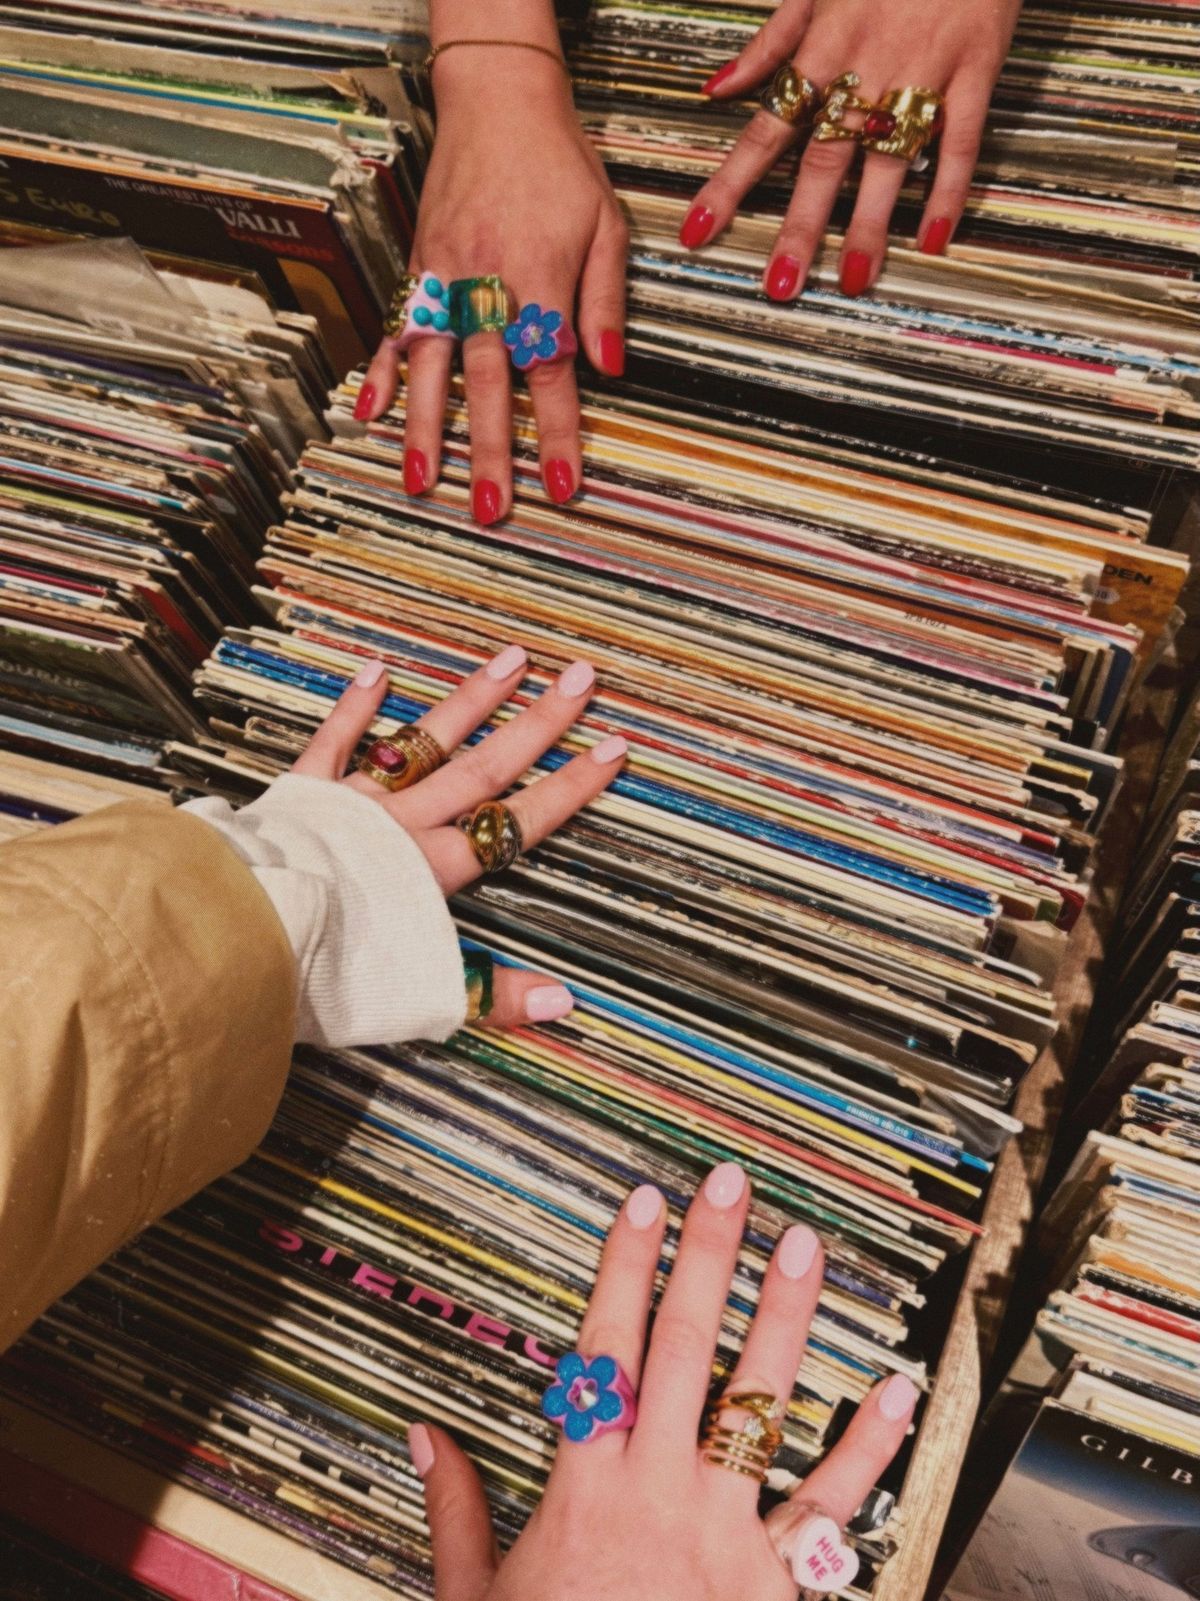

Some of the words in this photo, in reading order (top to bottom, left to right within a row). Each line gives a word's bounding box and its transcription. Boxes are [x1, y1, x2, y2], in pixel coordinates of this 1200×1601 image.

[103, 176, 128, 191] THE
[131, 180, 199, 201] GREATEST
[201, 191, 231, 207] HITS
[215, 207, 302, 239] VALLI
[1080, 1434, 1194, 1485] GILB
[806, 1554, 828, 1581] ME
[816, 1536, 844, 1574] HUG
